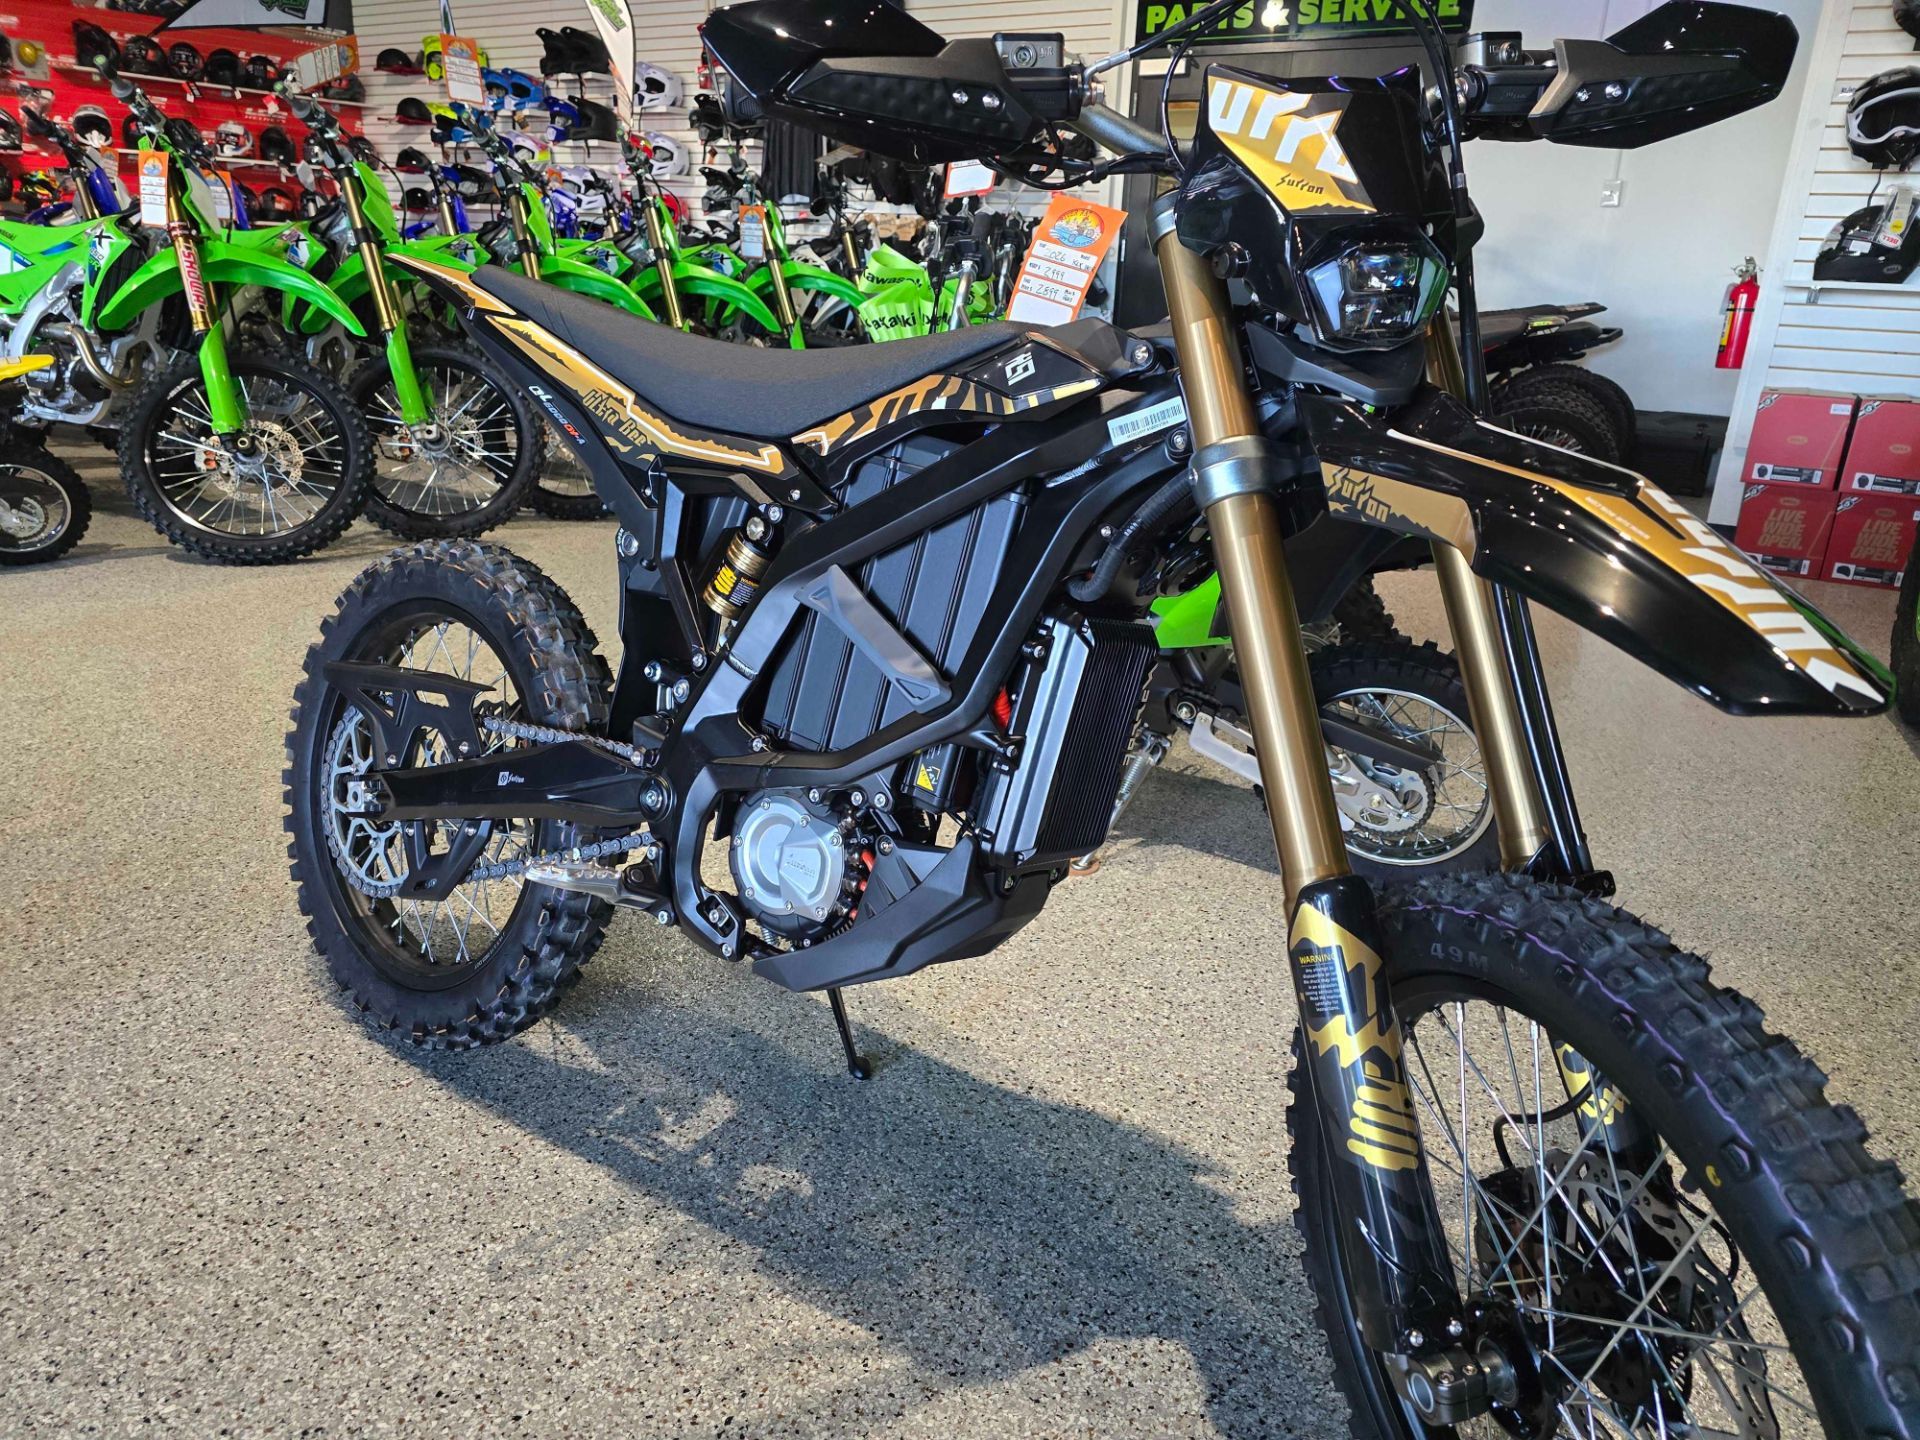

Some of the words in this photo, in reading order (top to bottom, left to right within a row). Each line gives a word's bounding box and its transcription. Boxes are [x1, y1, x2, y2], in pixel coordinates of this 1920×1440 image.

[1146, 0, 1254, 33] PAS
[1261, 0, 1290, 28] &
[1298, 0, 1459, 25] SERVE
[1768, 507, 1807, 524] LIVE
[1763, 519, 1806, 536] WIDE
[1863, 518, 1904, 535] LIVE
[1857, 531, 1902, 548] WIDE
